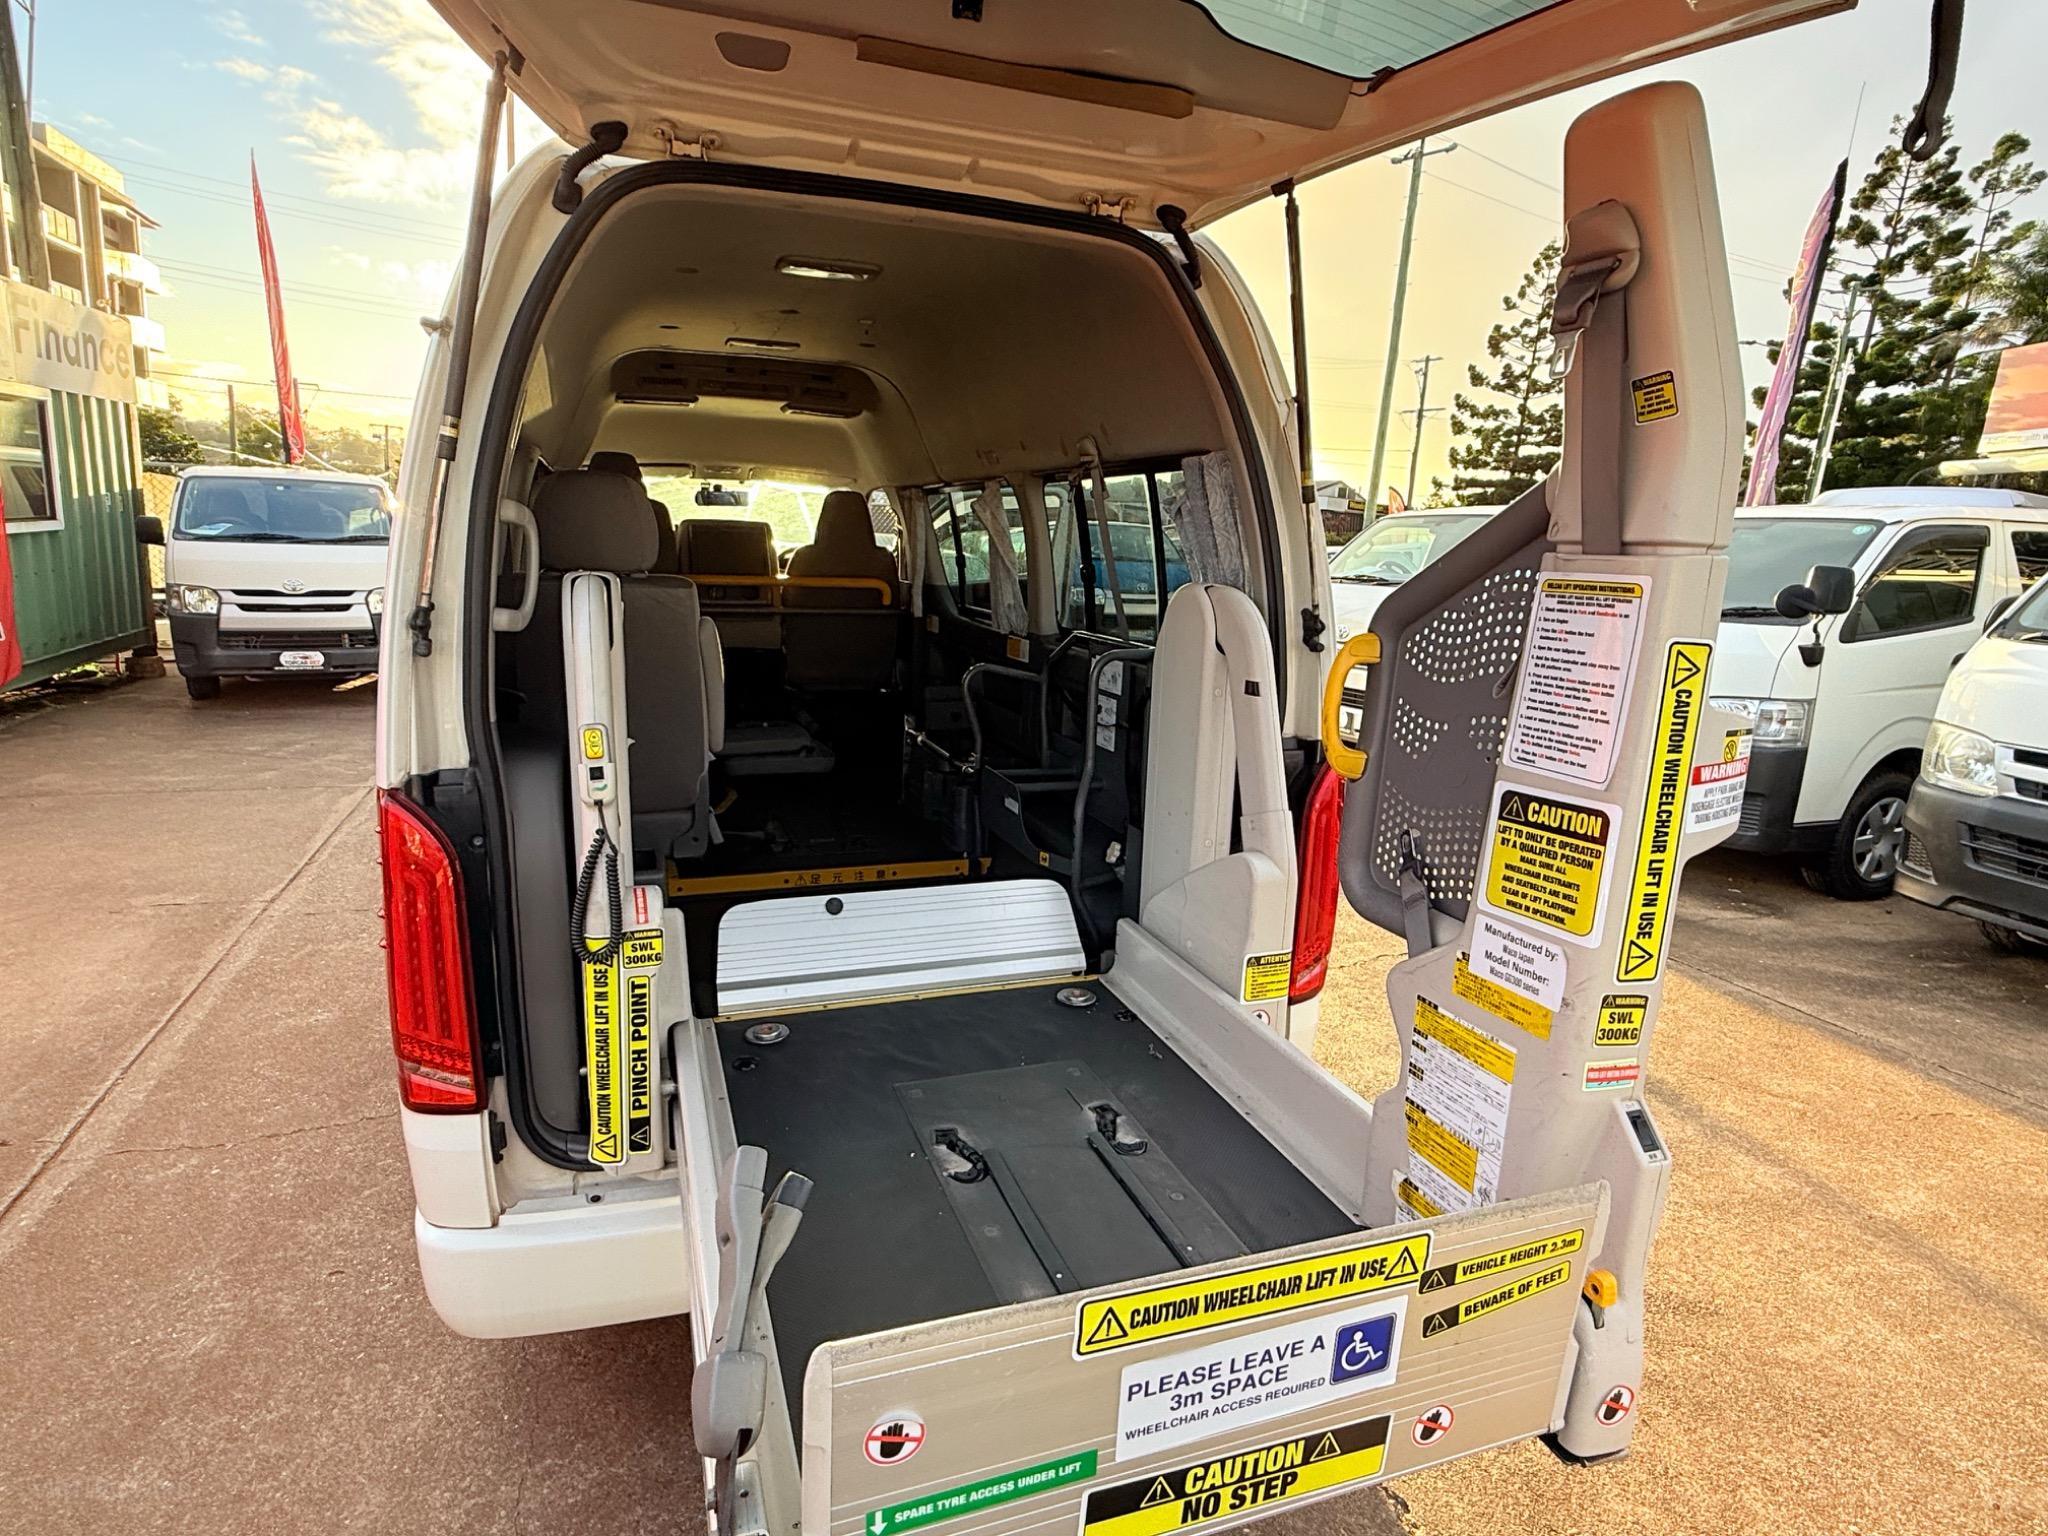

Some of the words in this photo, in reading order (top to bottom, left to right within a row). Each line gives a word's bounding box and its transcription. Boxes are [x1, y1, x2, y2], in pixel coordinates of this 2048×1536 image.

[10, 291, 130, 379] Finance
[1667, 689, 1692, 754] CAUTION
[1700, 758, 1748, 782] WARNING
[1527, 801, 1602, 838] CAUTION
[1650, 757, 1683, 855] WHEELCHAIR
[1498, 824, 1513, 835] LIFT
[1514, 827, 1522, 838] TO
[1525, 831, 1544, 843] ONLY
[1546, 836, 1556, 847] BE
[1558, 839, 1602, 860] OPERATED
[1500, 838, 1510, 846] BY
[1511, 840, 1517, 850] A
[1519, 842, 1558, 861] QUALIFIED
[1560, 853, 1594, 871] PERSON
[1504, 862, 1541, 880] WHEELCHAIR
[1542, 872, 1580, 892] RESTRAINTS
[1520, 855, 1537, 866] MAKE
[1538, 860, 1554, 872] SURE
[1555, 865, 1567, 875] ALL
[1645, 858, 1664, 888] LIFT
[1501, 885, 1519, 897] CLEAR
[1521, 891, 1528, 899] OF
[1530, 894, 1542, 904] LIFT
[1543, 897, 1576, 916] PLATFORM
[1502, 874, 1515, 884] AND
[1516, 878, 1547, 894] SEATBELTS
[1549, 888, 1560, 898] ARE
[1562, 891, 1578, 904] WELL
[1506, 898, 1522, 910] WHEN
[1524, 904, 1530, 913] IN
[1643, 891, 1659, 907] IN
[1485, 922, 1543, 955] Manufactured
[1544, 946, 1558, 962] by:
[1636, 912, 1655, 940] USE
[625, 952, 662, 965] 300KG
[631, 942, 655, 952] SWL
[593, 967, 609, 985] USE
[1485, 949, 1510, 968] Model
[1512, 962, 1550, 987] Number:
[594, 987, 608, 1001] IN
[630, 980, 648, 1042] POINT
[1615, 997, 1646, 1006] WARNING
[594, 1002, 609, 1026] LIFT
[1608, 1012, 1634, 1024] SWL
[1598, 1027, 1639, 1041] 300KG
[595, 1027, 611, 1091] WHEELCHAIR
[631, 1048, 648, 1112] PINCH
[597, 1096, 611, 1137] CAUTION
[1461, 1255, 1508, 1277] VEHICLE
[1509, 1244, 1548, 1264] HEIGHT
[1550, 1237, 1577, 1252] 2.3m
[1129, 1294, 1200, 1330] CAUTION
[1203, 1273, 1304, 1314] WHEELCHAIR
[1305, 1265, 1338, 1294] LIFT
[1339, 1262, 1356, 1284] IN
[1359, 1256, 1388, 1280] USE
[1464, 1288, 1514, 1318] BEWARE
[1517, 1280, 1533, 1296] OF
[1536, 1268, 1564, 1288] FEET
[1127, 1361, 1223, 1402] PLEASE
[1229, 1340, 1304, 1375] LEAVE
[1310, 1335, 1326, 1353] A
[1170, 1389, 1203, 1412] 3m
[1211, 1364, 1290, 1401] SPACE
[1125, 1409, 1209, 1440] WHEELCHAIR
[1212, 1394, 1262, 1417] ACCESS
[1265, 1376, 1326, 1402] REQUIRED
[1182, 1440, 1306, 1496] CAUTION
[894, 1502, 933, 1524] SPARE
[936, 1493, 966, 1513] TYRE
[968, 1482, 1014, 1506] ACCESS
[1017, 1471, 1055, 1494] UNDER
[1056, 1461, 1082, 1482] LIFT
[1179, 1491, 1222, 1526] NO
[1228, 1471, 1300, 1512] STEP
